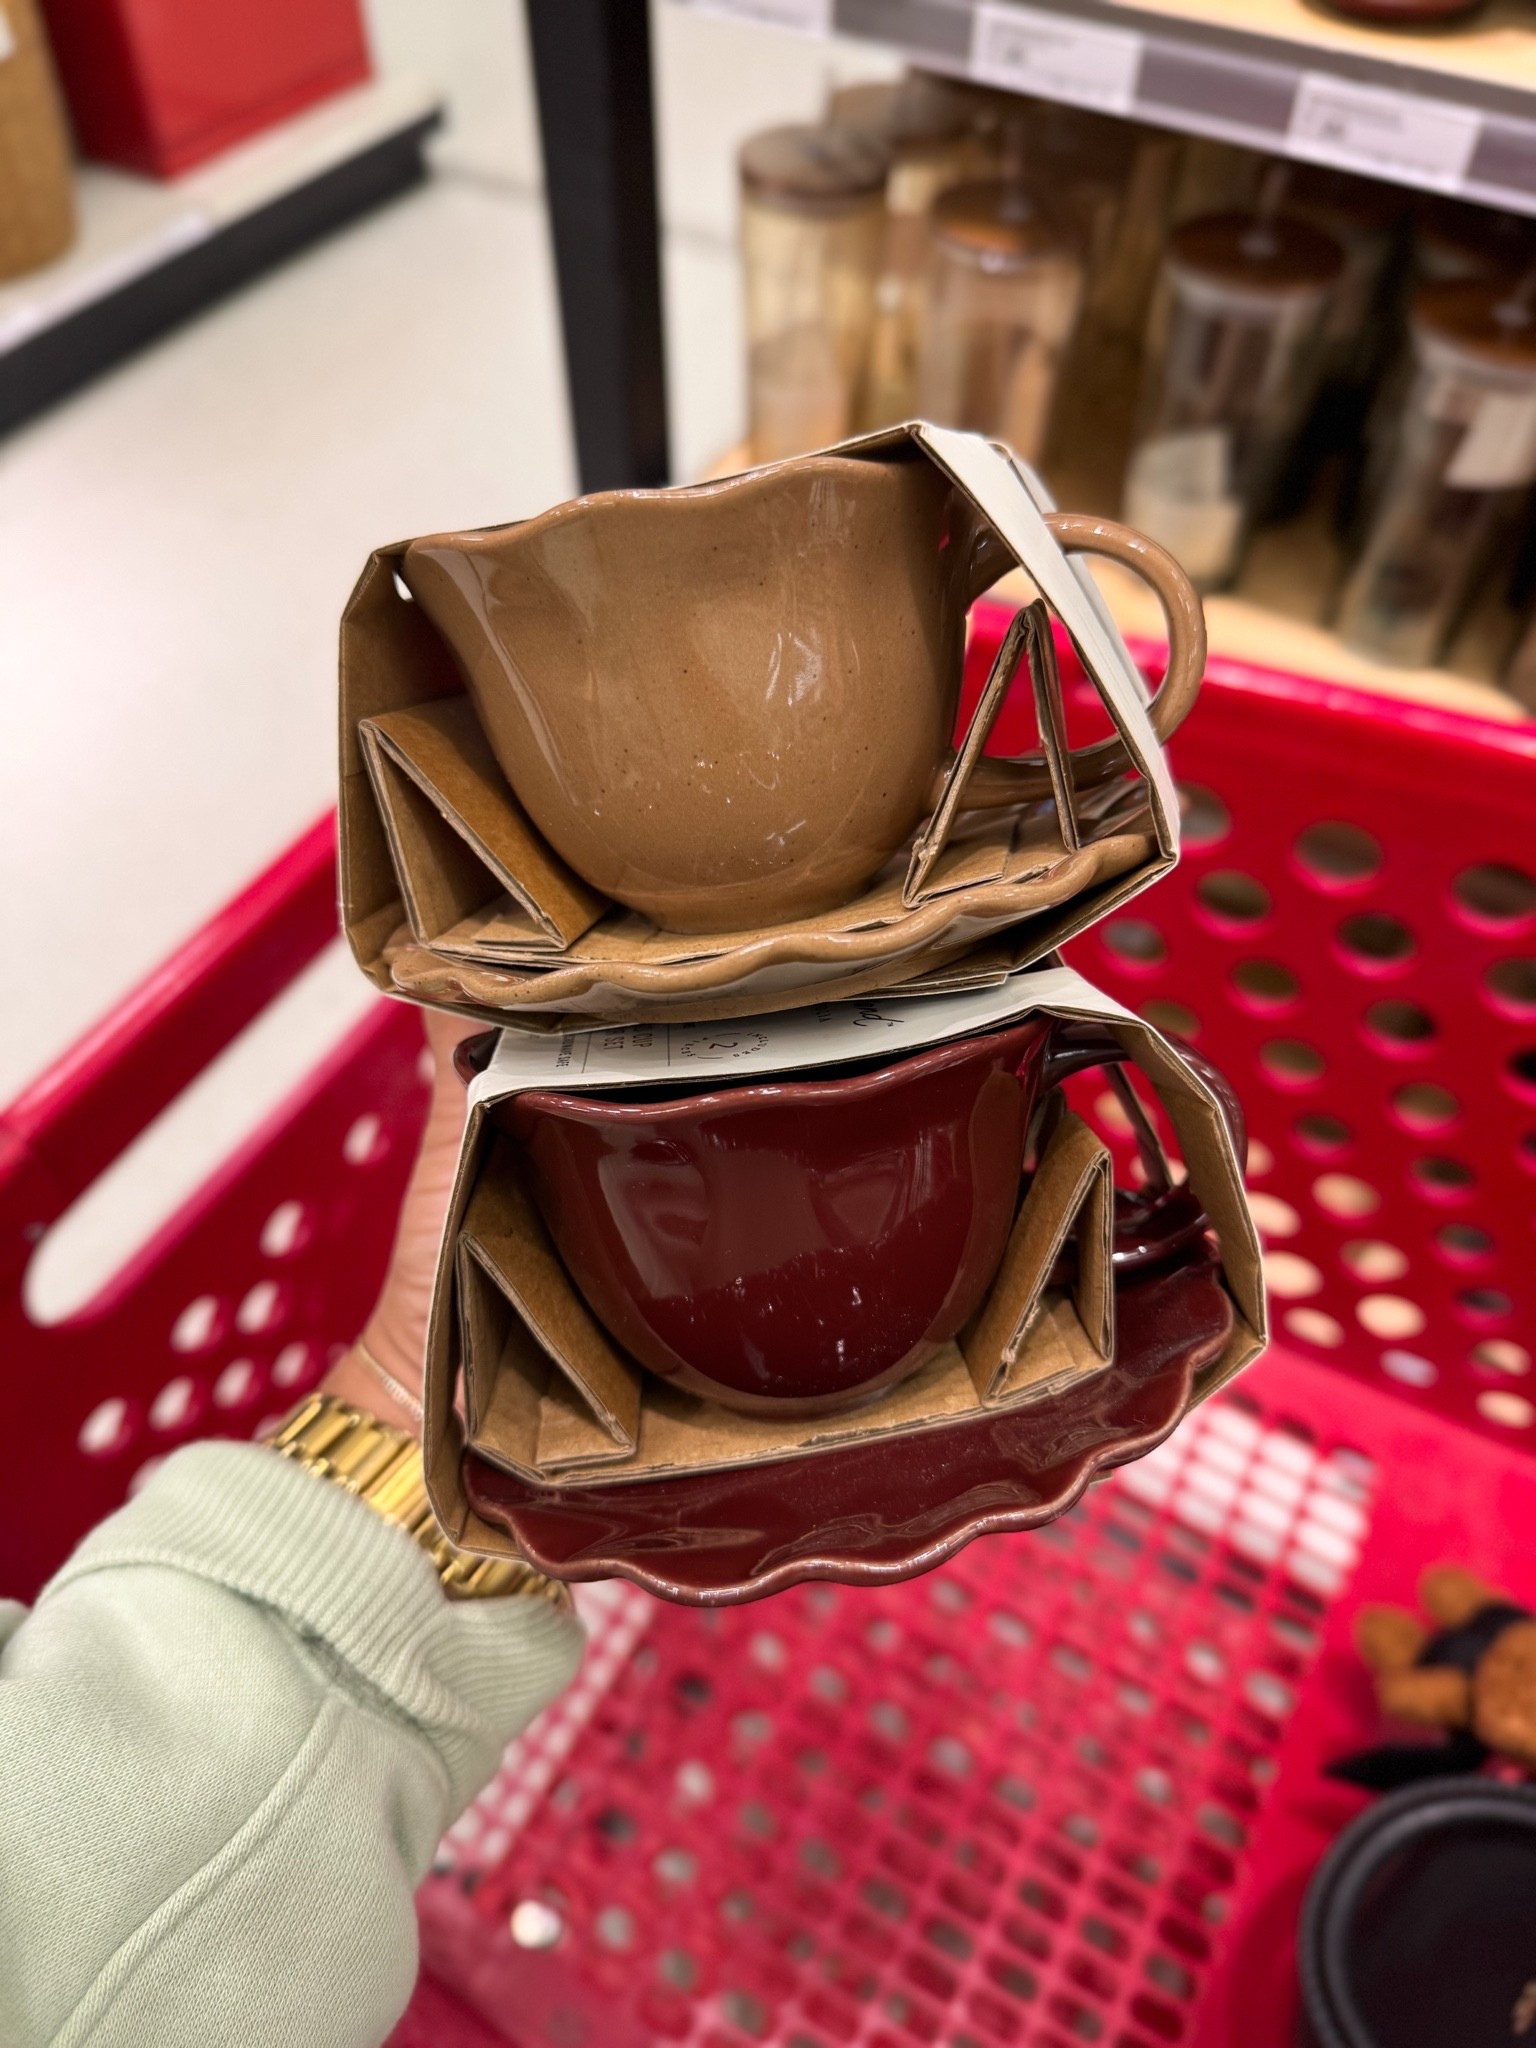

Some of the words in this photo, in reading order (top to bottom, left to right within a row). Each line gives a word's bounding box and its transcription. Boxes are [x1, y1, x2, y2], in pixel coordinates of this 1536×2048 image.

[603, 1036, 625, 1050] SET
[631, 1033, 653, 1048] CUP
[708, 1041, 739, 1050] 2
